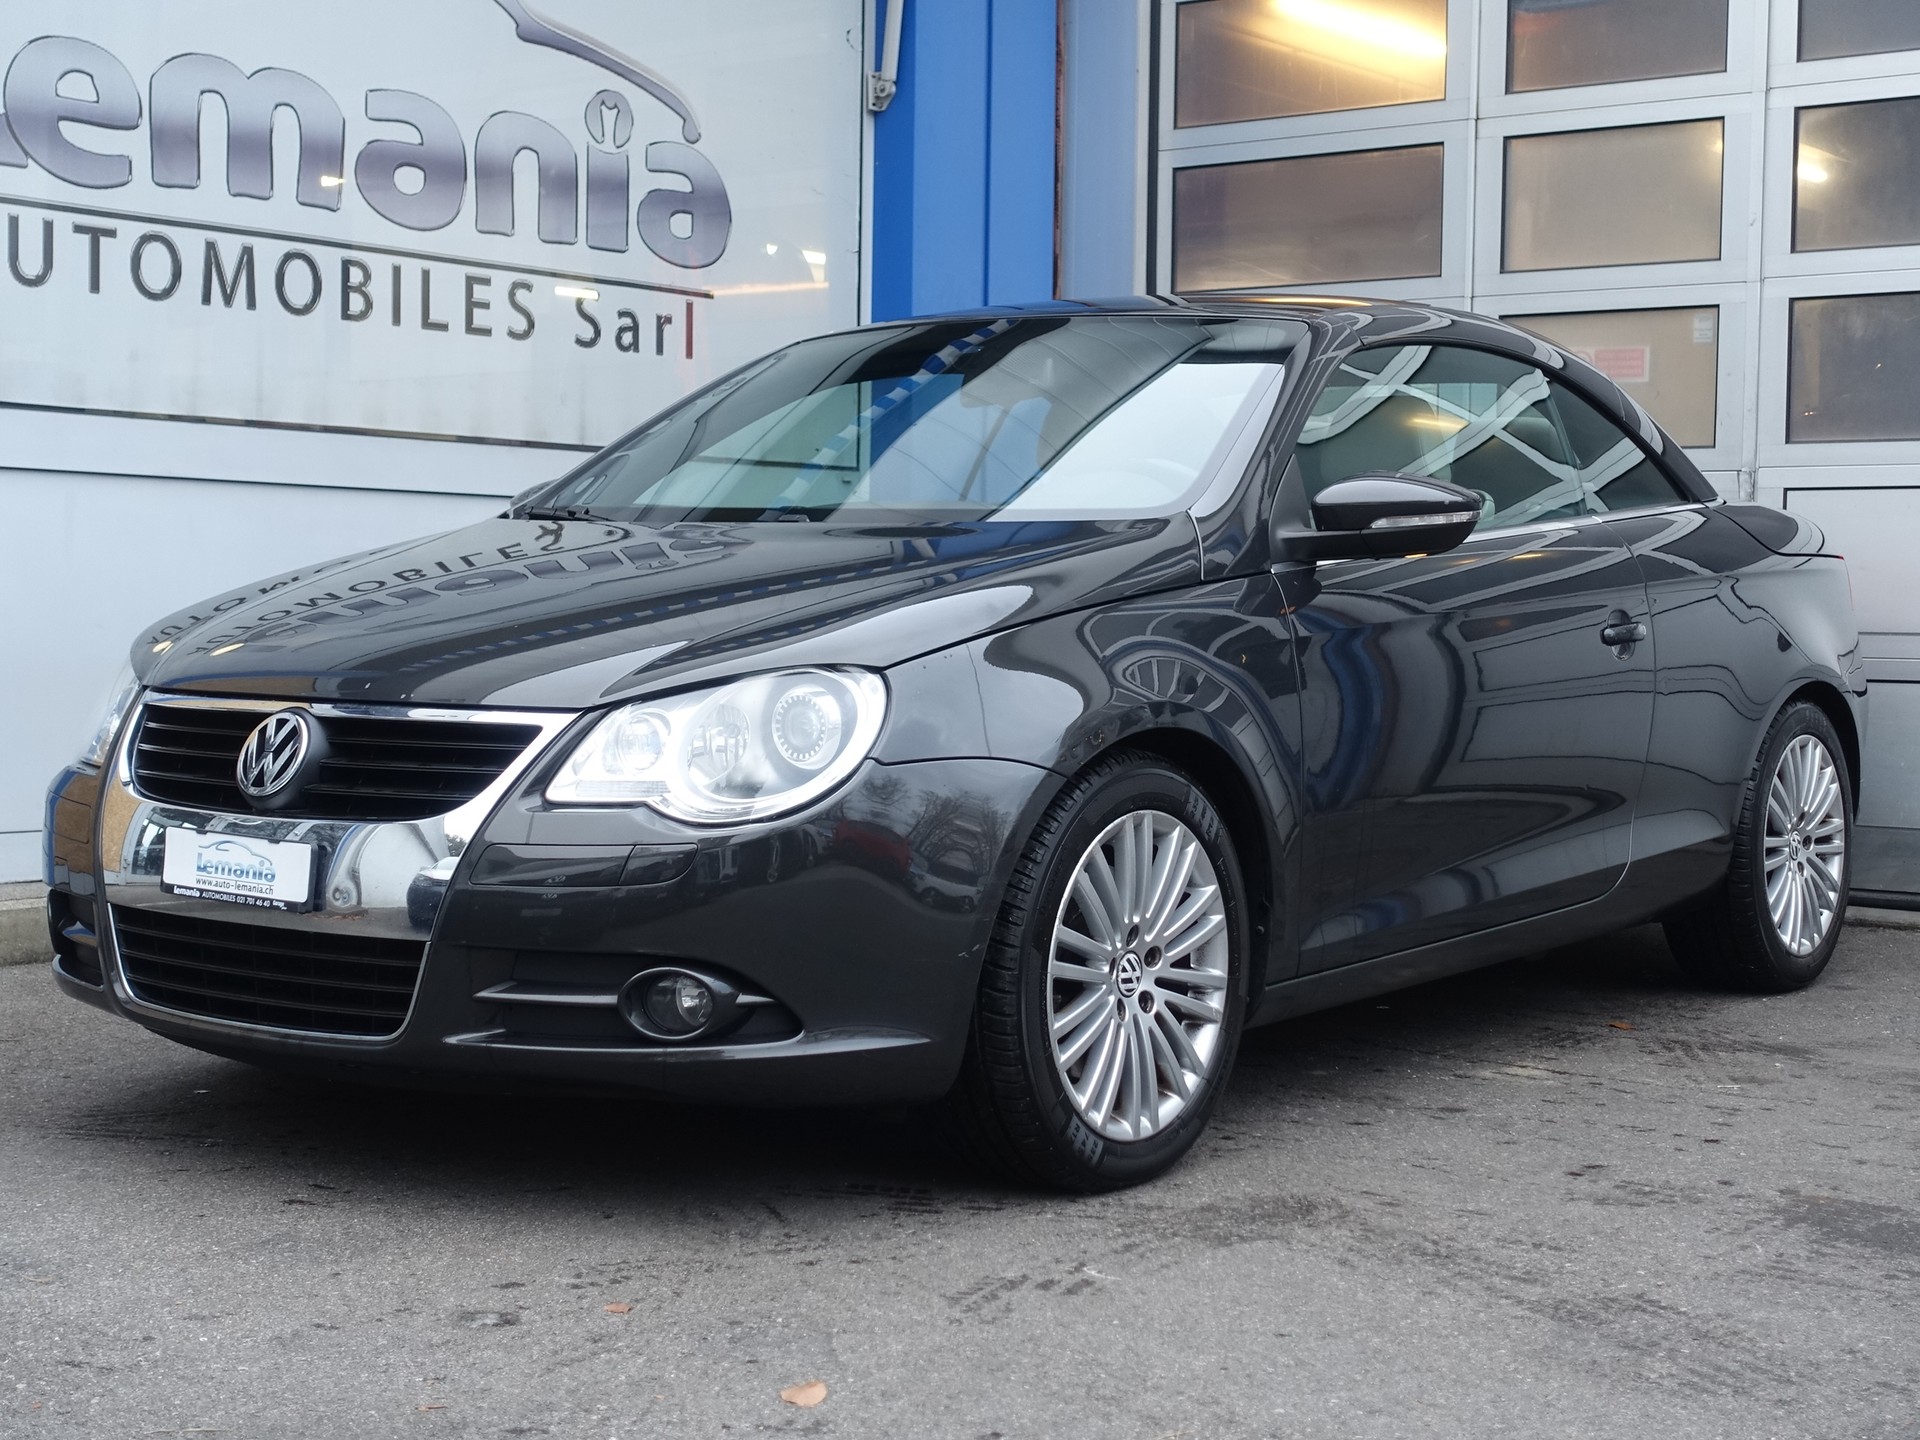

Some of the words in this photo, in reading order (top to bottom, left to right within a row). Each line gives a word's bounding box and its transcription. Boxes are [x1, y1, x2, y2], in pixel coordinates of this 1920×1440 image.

[574, 287, 693, 360] Sarl
[196, 852, 275, 882] Lemania
[196, 878, 274, 895] www.auto-lemania.ch
[201, 891, 236, 902] AUTOMOBILES
